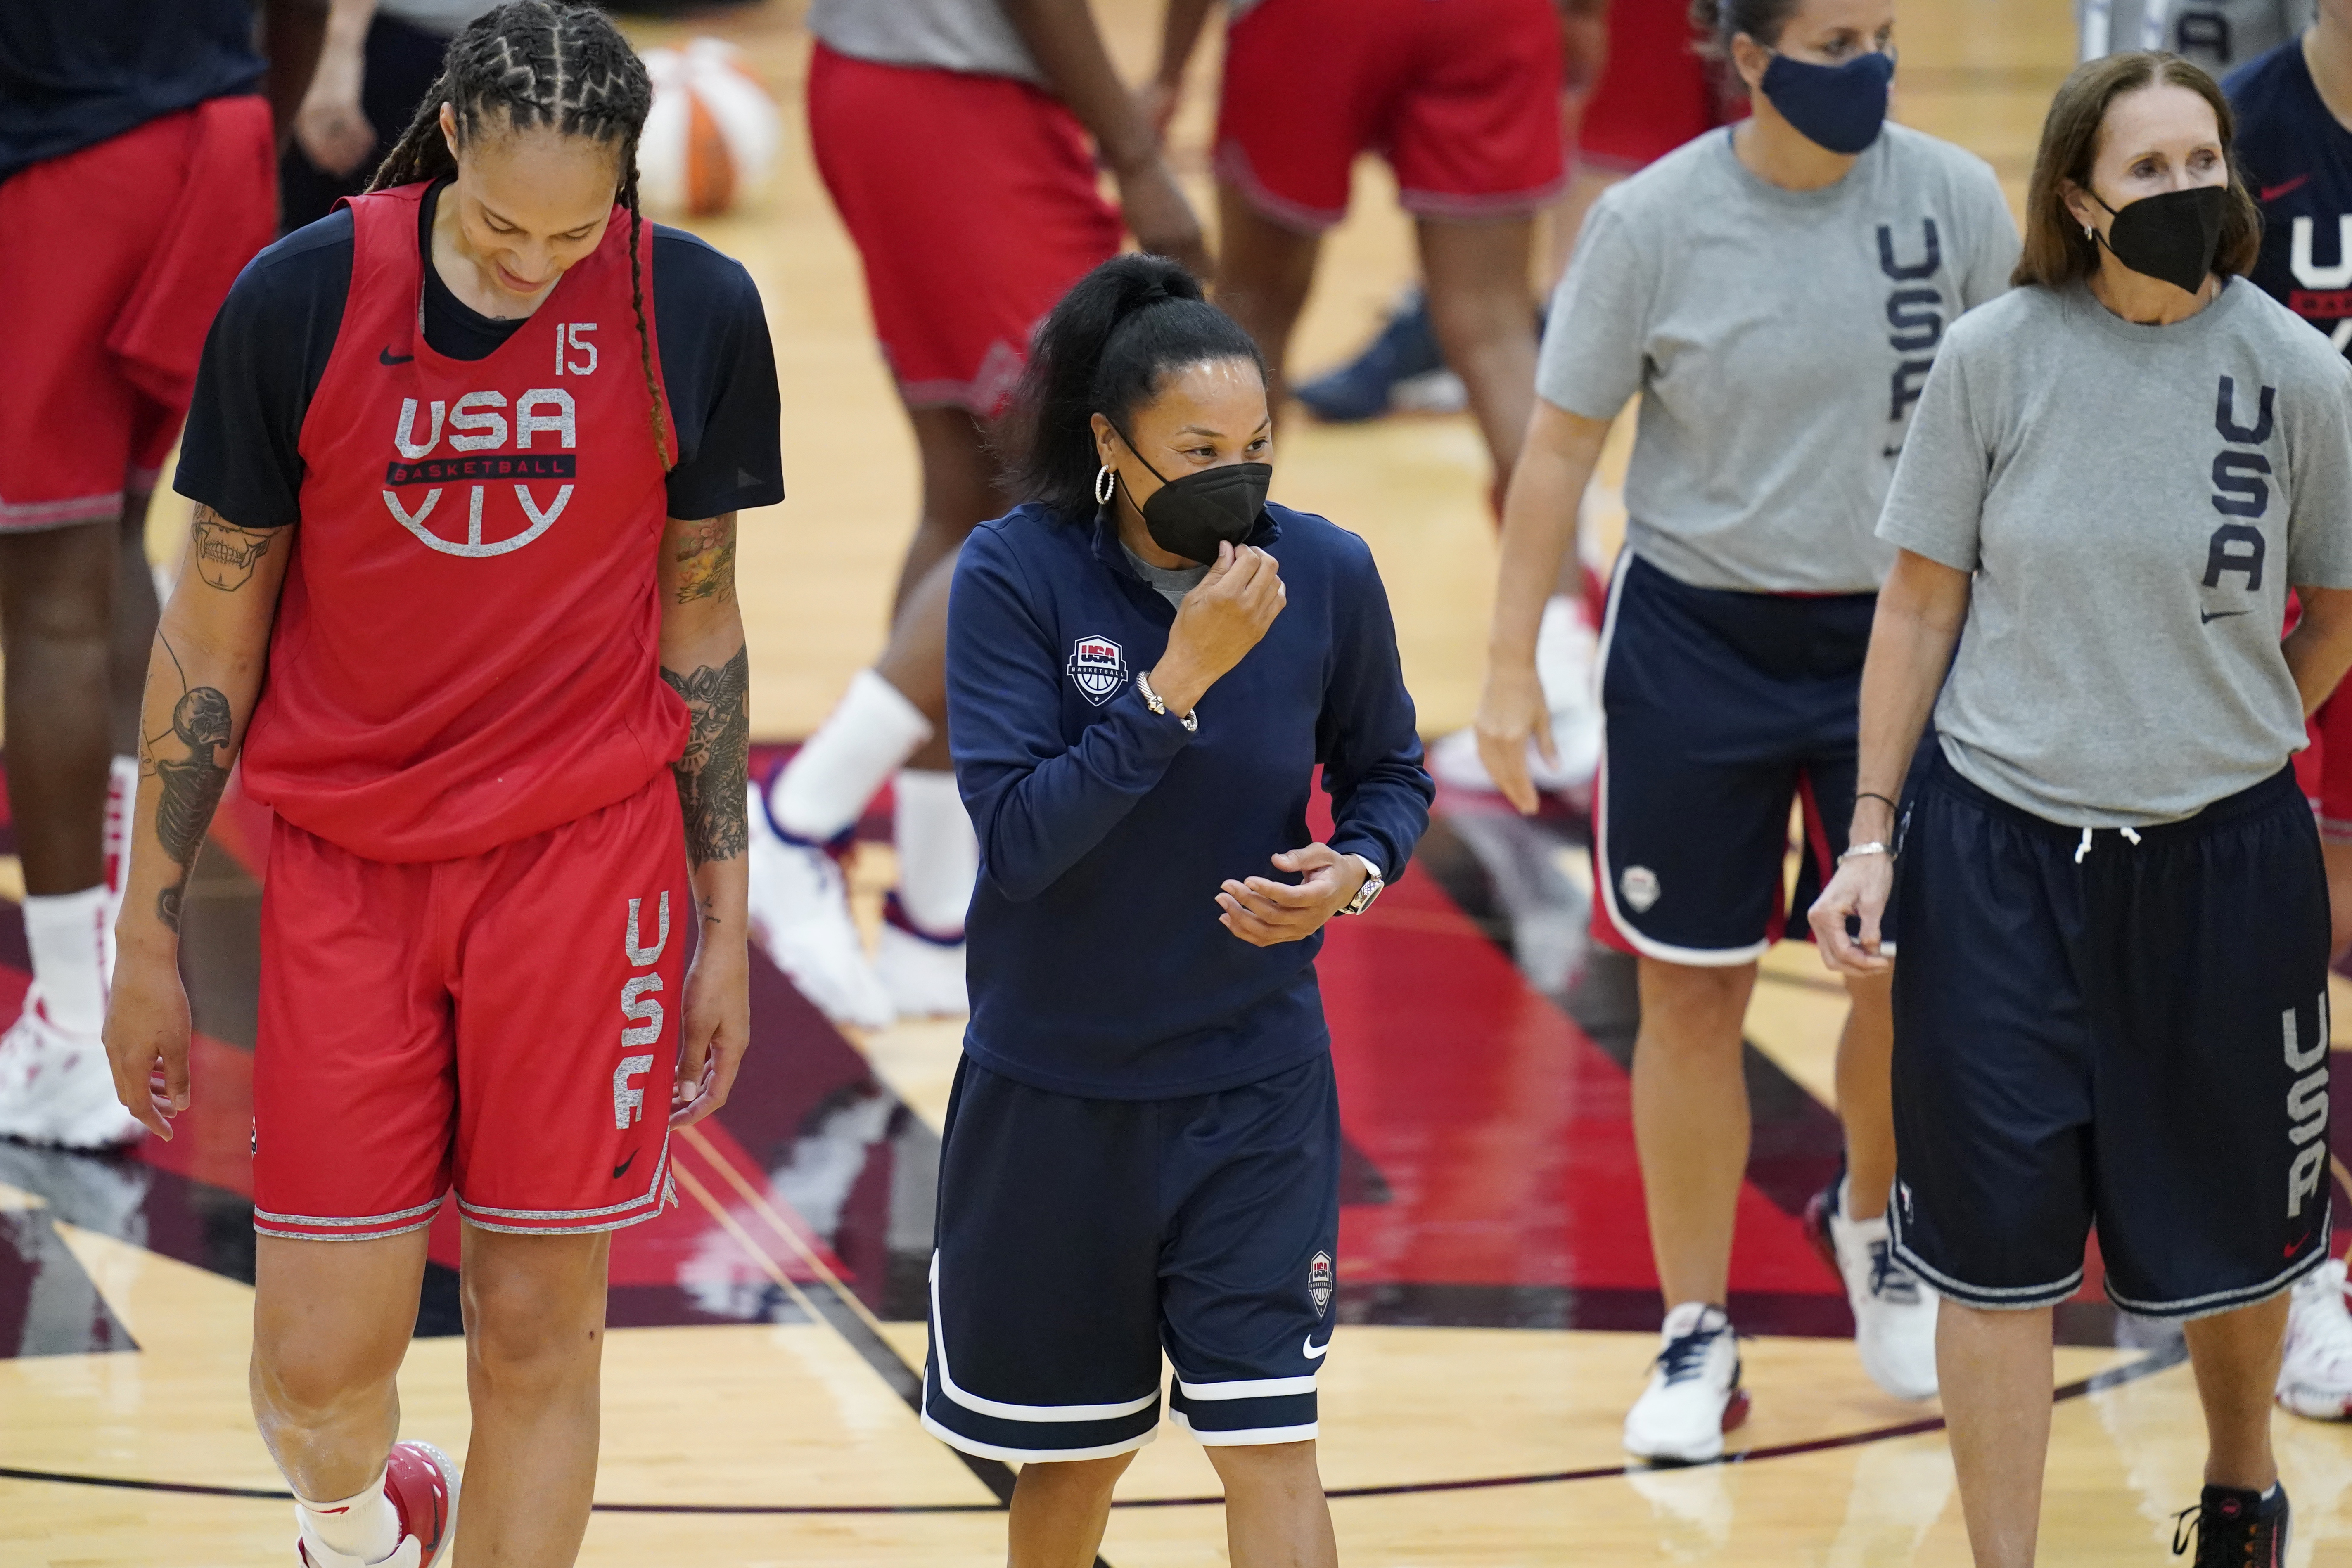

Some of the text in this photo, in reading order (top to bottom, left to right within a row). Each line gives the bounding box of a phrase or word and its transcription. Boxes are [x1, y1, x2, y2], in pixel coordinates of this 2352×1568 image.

[556, 323, 597, 375] 15
[394, 388, 576, 459] USA
[394, 460, 564, 482] BASKETBALL
[2201, 374, 2276, 591] USA
[1071, 667, 1124, 677] BASKETBALL
[1081, 645, 1116, 666] USA
[613, 890, 670, 1130] USA
[2282, 990, 2329, 1218] USA
[1314, 1262, 1328, 1278] USA
